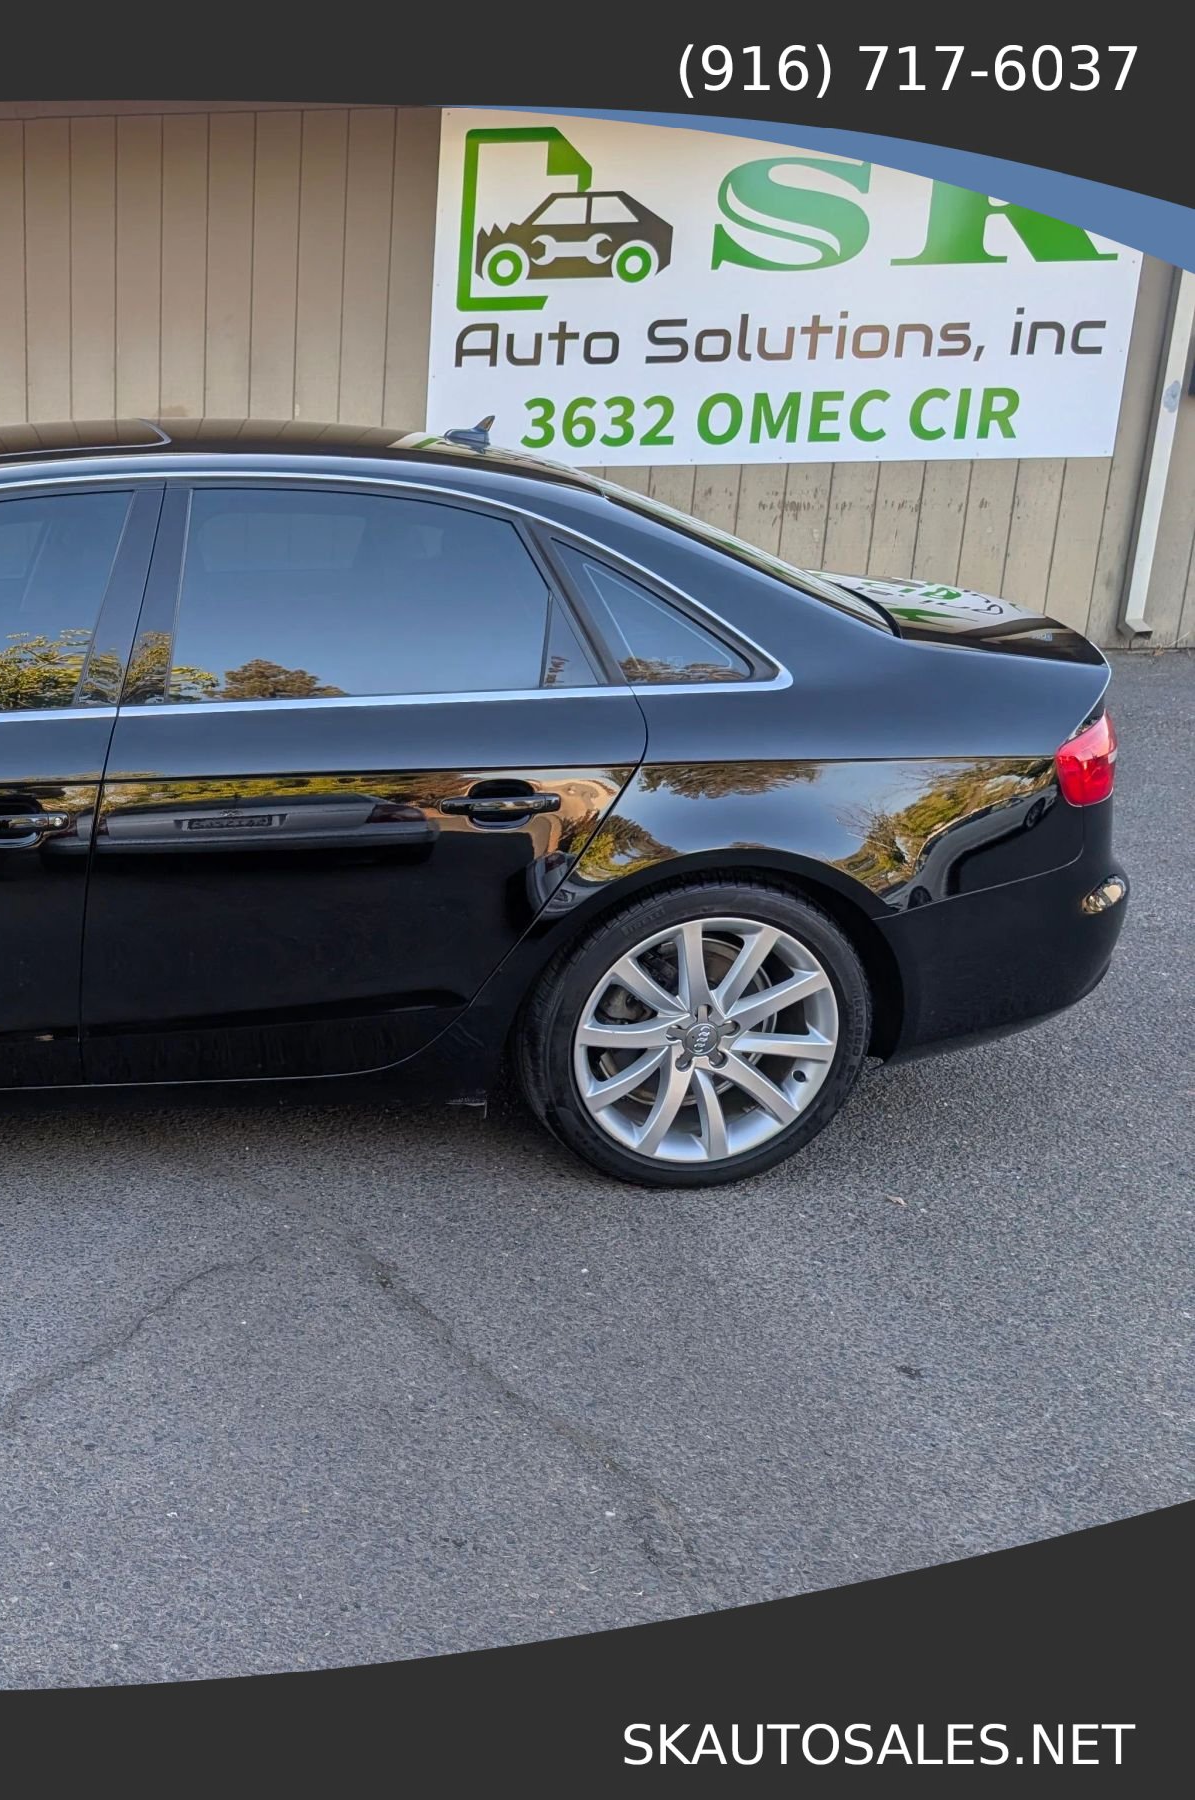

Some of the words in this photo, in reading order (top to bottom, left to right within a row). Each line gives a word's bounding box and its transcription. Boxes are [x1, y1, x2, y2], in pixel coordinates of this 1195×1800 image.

[455, 321, 619, 368] Auto
[645, 311, 985, 364] Solutions,
[1010, 307, 1107, 356] inc
[520, 395, 675, 448] 3632
[697, 389, 892, 445] OMEC
[909, 387, 1020, 441] CIR
